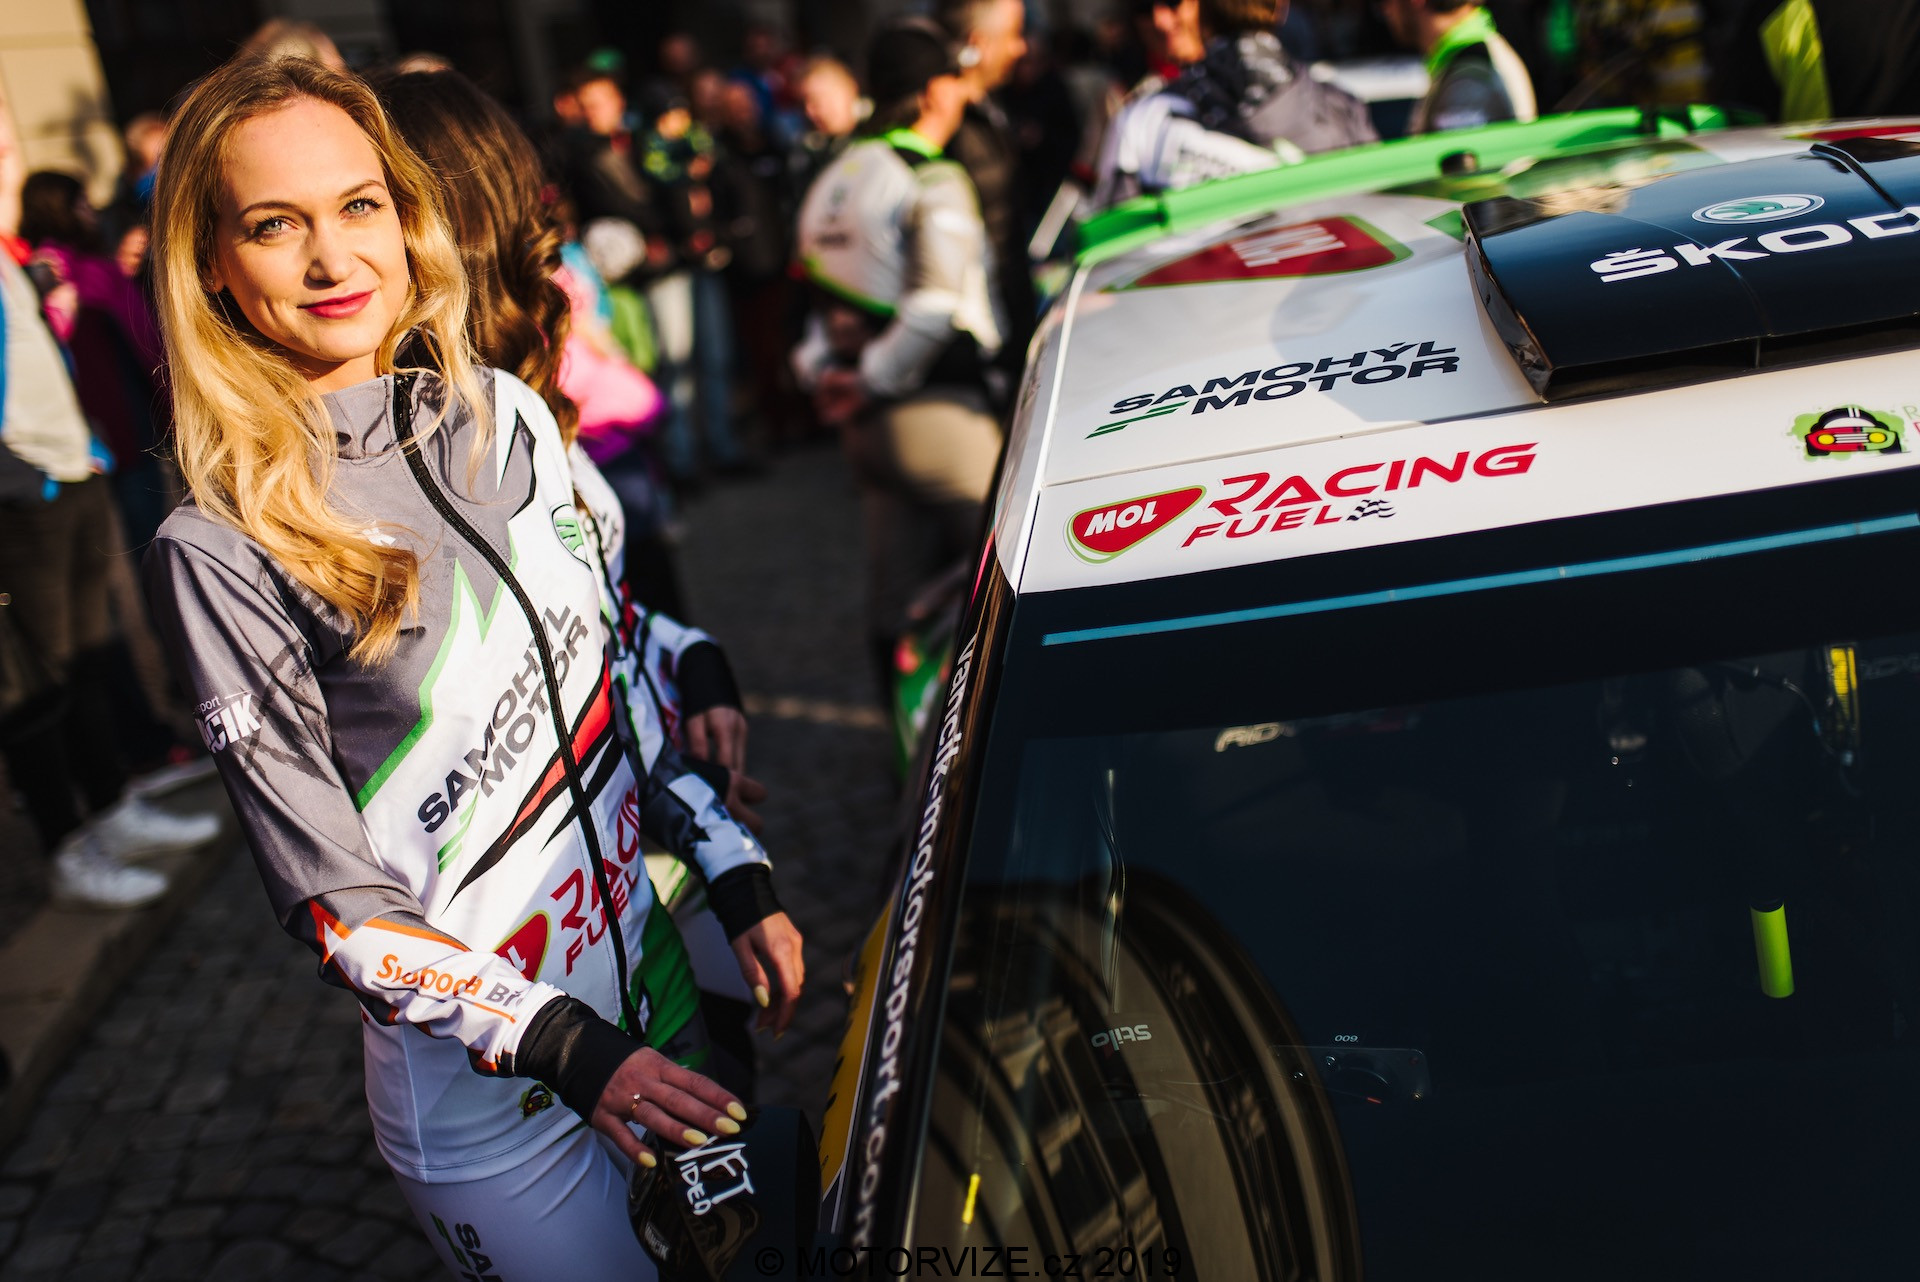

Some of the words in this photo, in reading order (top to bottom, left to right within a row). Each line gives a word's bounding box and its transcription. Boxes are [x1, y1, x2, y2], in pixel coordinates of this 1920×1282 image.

[1109, 341, 1457, 414] SAMOHÝL
[1191, 356, 1460, 414] MOTOR
[1207, 442, 1540, 515] RACING
[1083, 501, 1158, 537] MOL
[1181, 503, 1345, 548] FUEL
[477, 614, 589, 798] MOTOR
[566, 869, 640, 977] FUEL
[455, 1222, 503, 1282] SA
